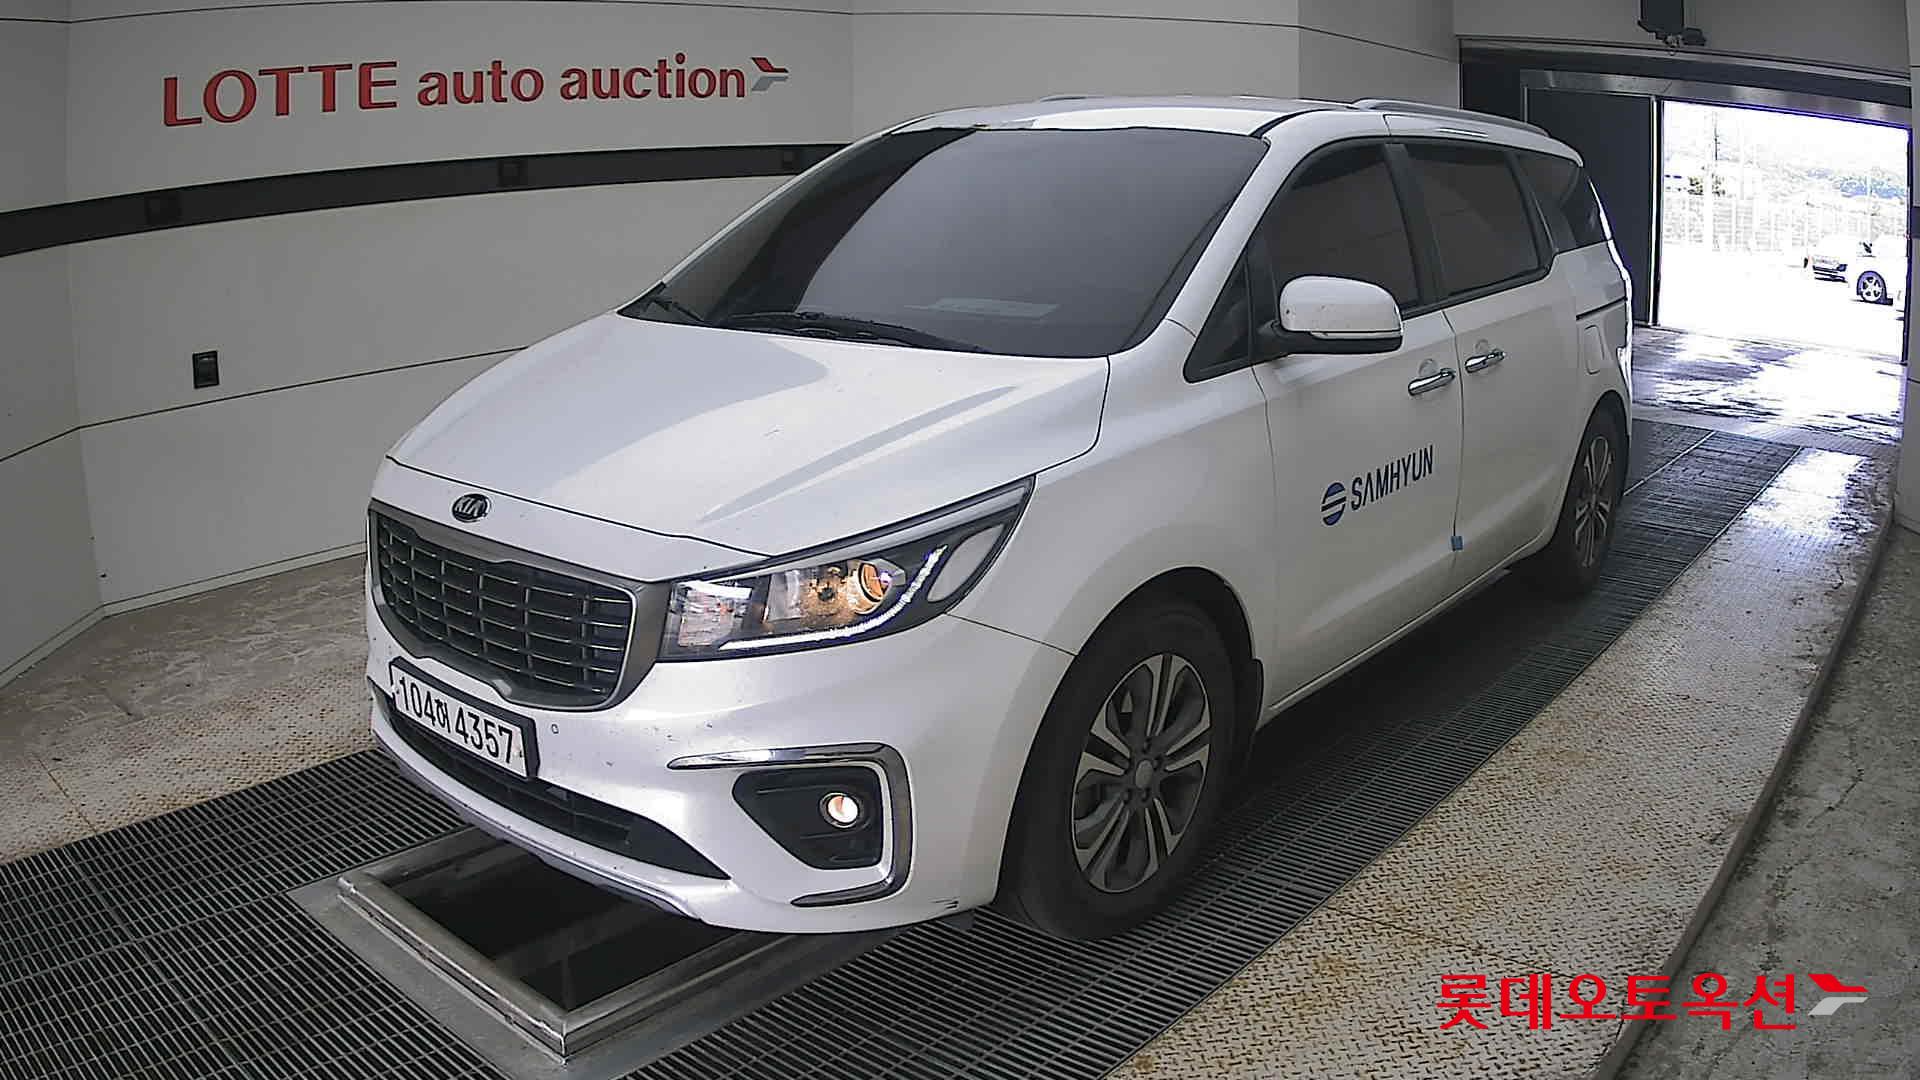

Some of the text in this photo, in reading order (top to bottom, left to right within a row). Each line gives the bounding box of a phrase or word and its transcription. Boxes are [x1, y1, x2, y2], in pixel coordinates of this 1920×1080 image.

[163, 52, 746, 127] LOTTE auto auction
[1351, 444, 1434, 511] SAMHYUN
[455, 707, 513, 764] 4357
